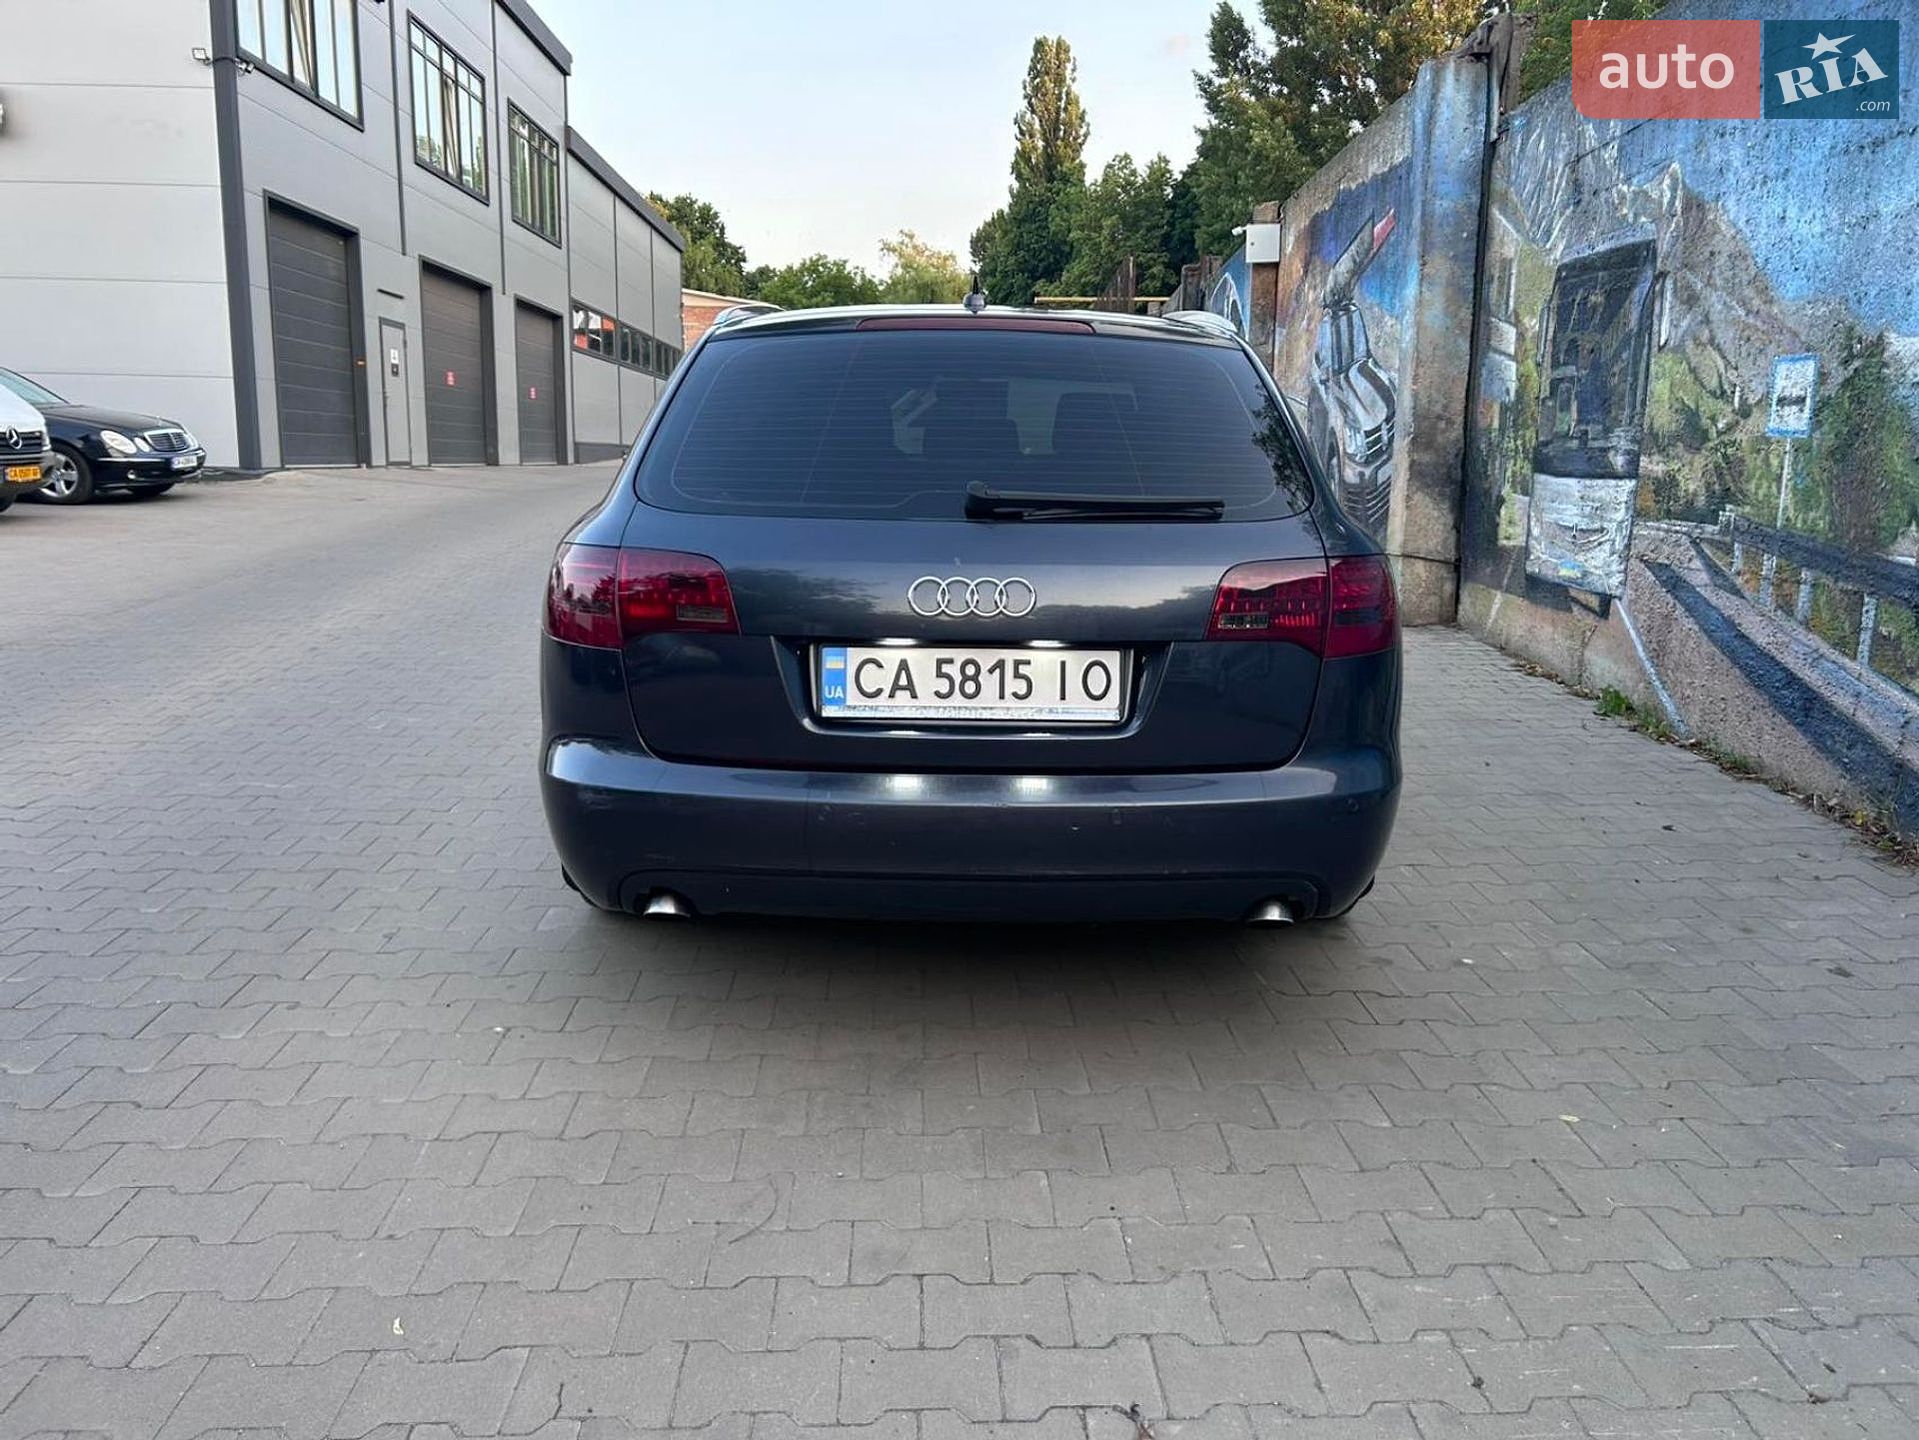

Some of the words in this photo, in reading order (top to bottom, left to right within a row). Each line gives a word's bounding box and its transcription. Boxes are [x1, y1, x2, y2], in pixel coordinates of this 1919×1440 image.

[825, 686, 844, 699] UA
[854, 657, 918, 699] CA
[934, 658, 1033, 700] 5815
[1060, 659, 1112, 701] IO
